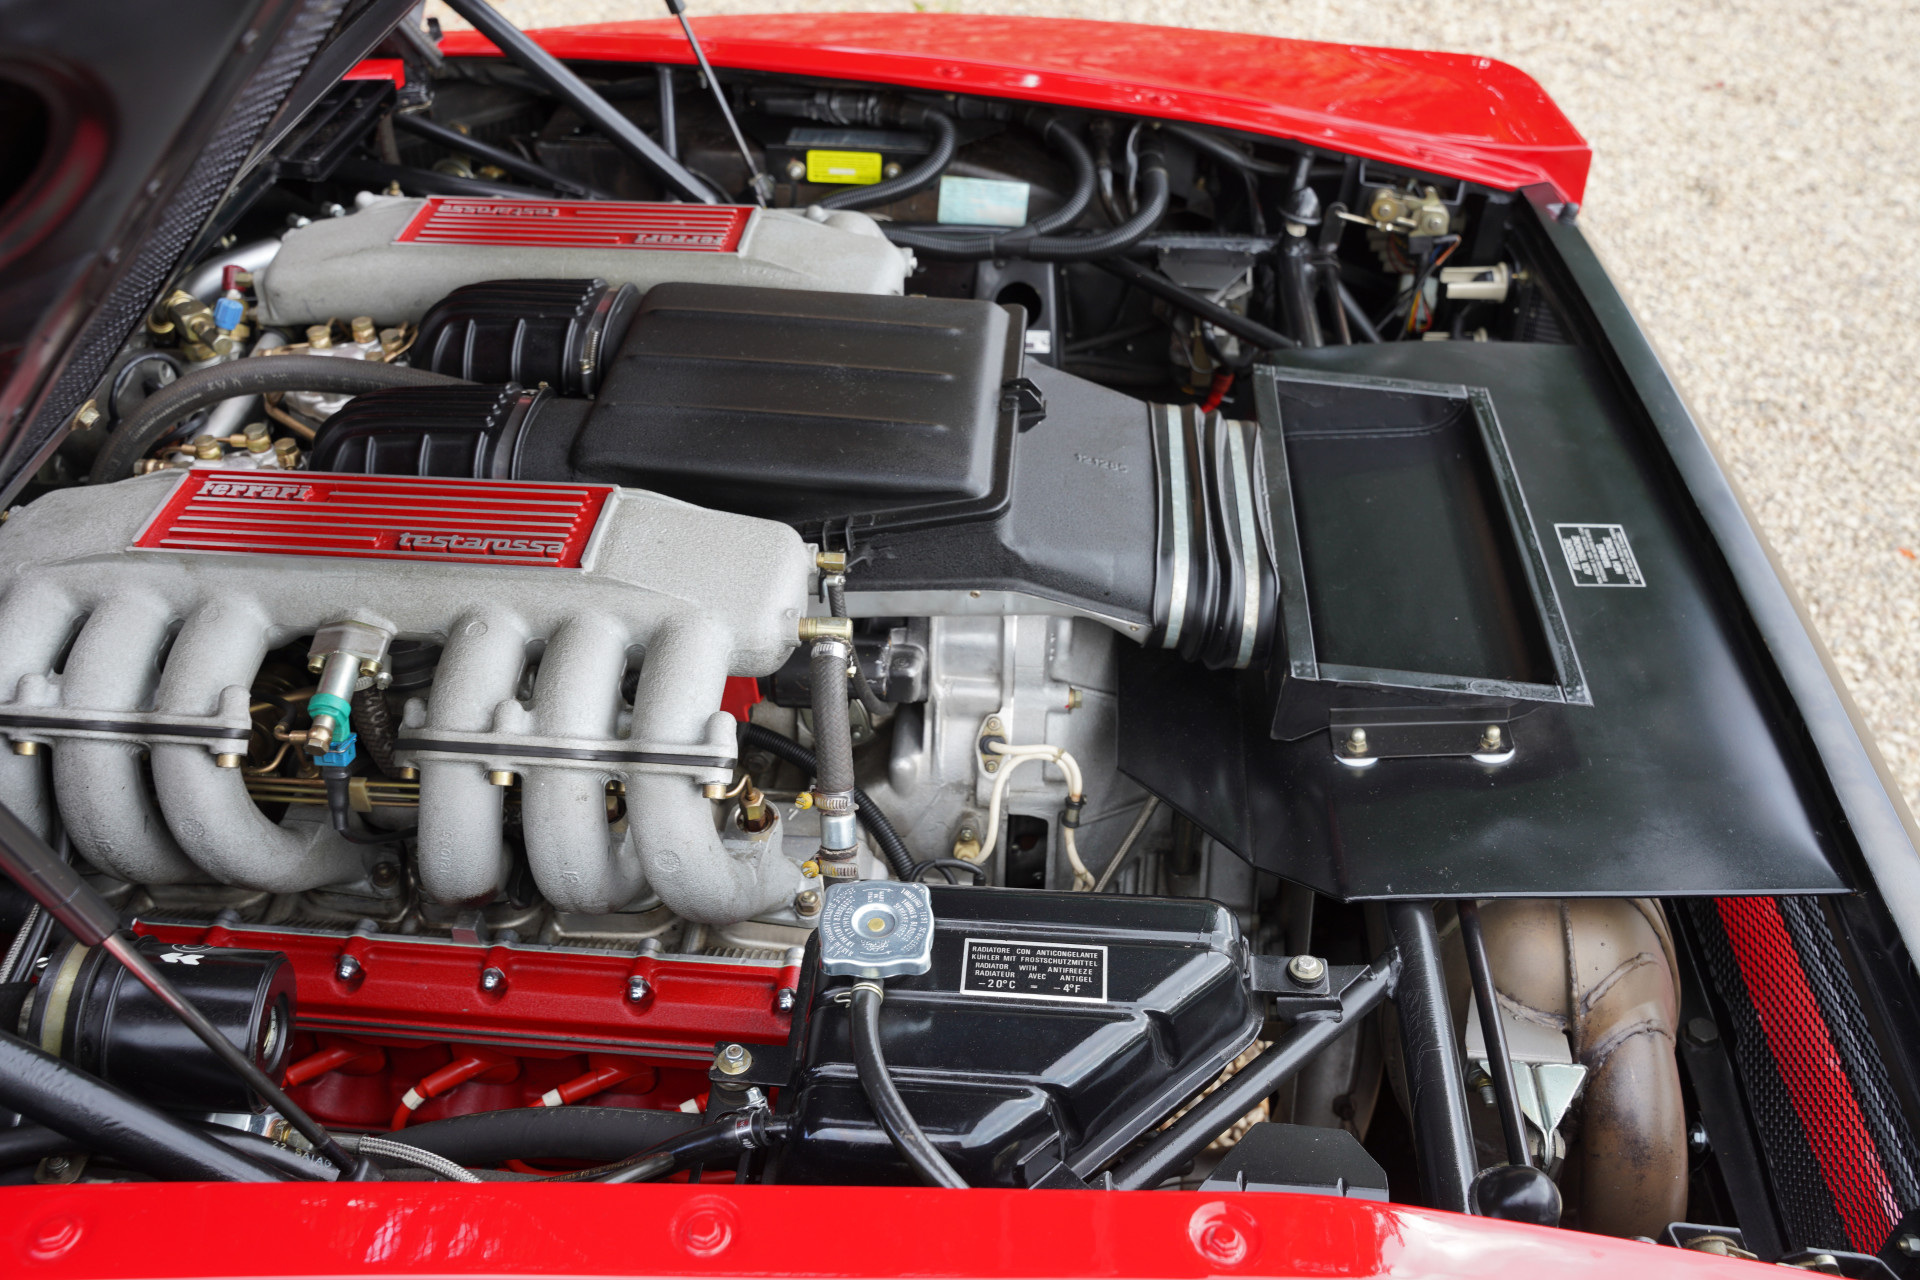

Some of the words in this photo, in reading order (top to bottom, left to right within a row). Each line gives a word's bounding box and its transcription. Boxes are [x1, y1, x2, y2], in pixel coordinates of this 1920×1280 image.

[438, 204, 560, 218] testarossa
[634, 233, 726, 246] Ferrari
[200, 480, 312, 500] Ferrari
[399, 531, 565, 554] testarossa
[1036, 950, 1098, 958] ANTICONGELANTE
[1021, 957, 1098, 966] FROSTSCHUTZMITTEL
[975, 970, 1015, 978] RADIATEUR
[1048, 967, 1092, 975] ANTIFREEZE
